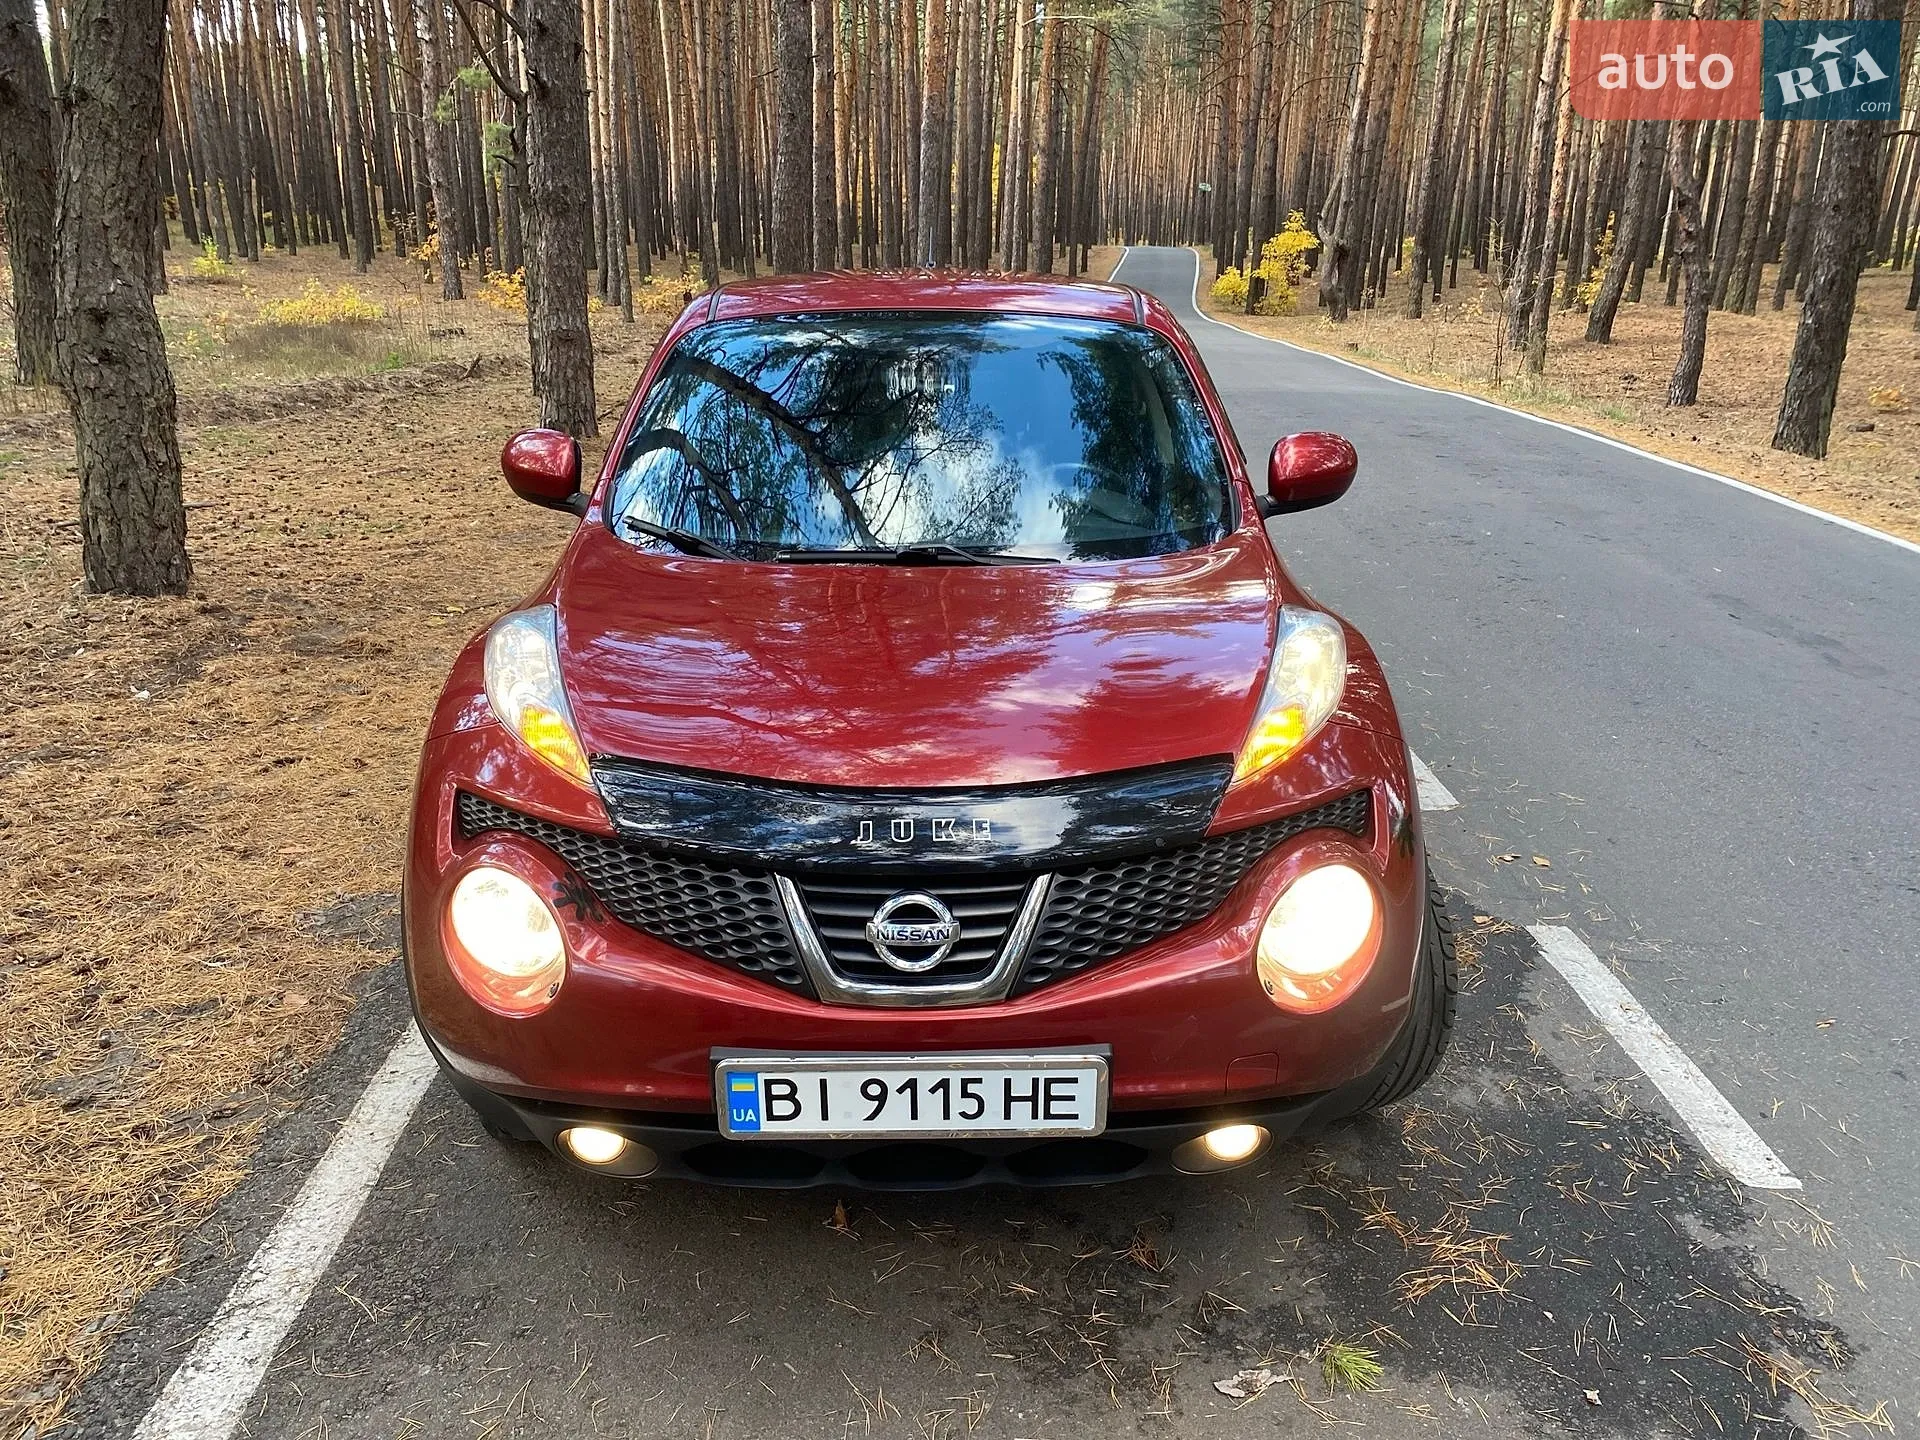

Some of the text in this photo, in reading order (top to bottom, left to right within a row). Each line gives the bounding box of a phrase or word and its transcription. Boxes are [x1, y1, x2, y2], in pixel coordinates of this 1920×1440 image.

[852, 818, 992, 844] JUKE
[876, 928, 950, 942] NISSAN
[763, 1076, 1080, 1122] BI 9115 HE
[733, 1108, 757, 1123] UA
